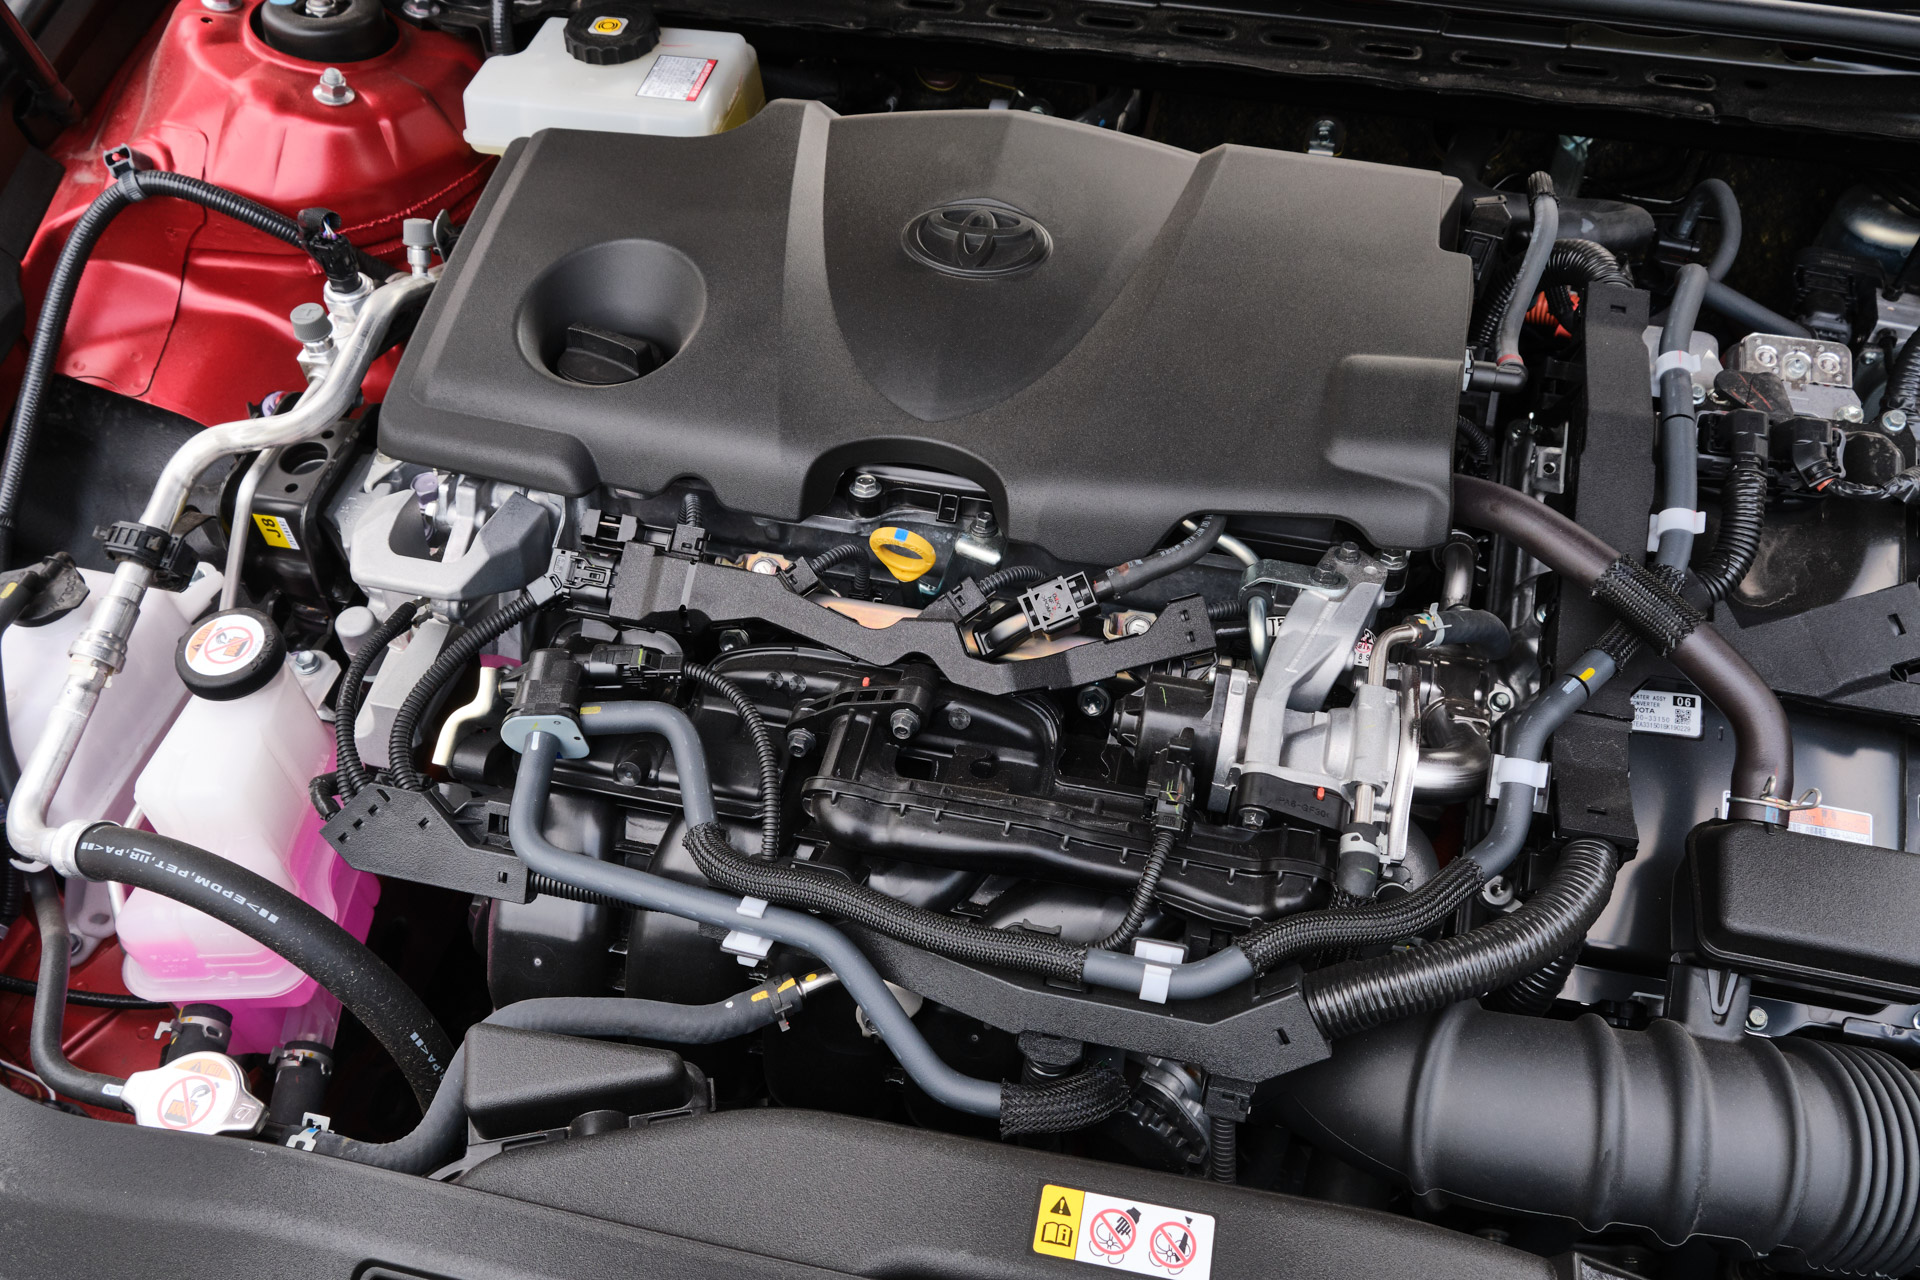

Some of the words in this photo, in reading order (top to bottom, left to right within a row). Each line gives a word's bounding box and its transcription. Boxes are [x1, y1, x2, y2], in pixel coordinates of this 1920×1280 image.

[261, 518, 281, 538] J8
[1676, 696, 1692, 707] 06
[1635, 714, 1671, 723] 00-33150
